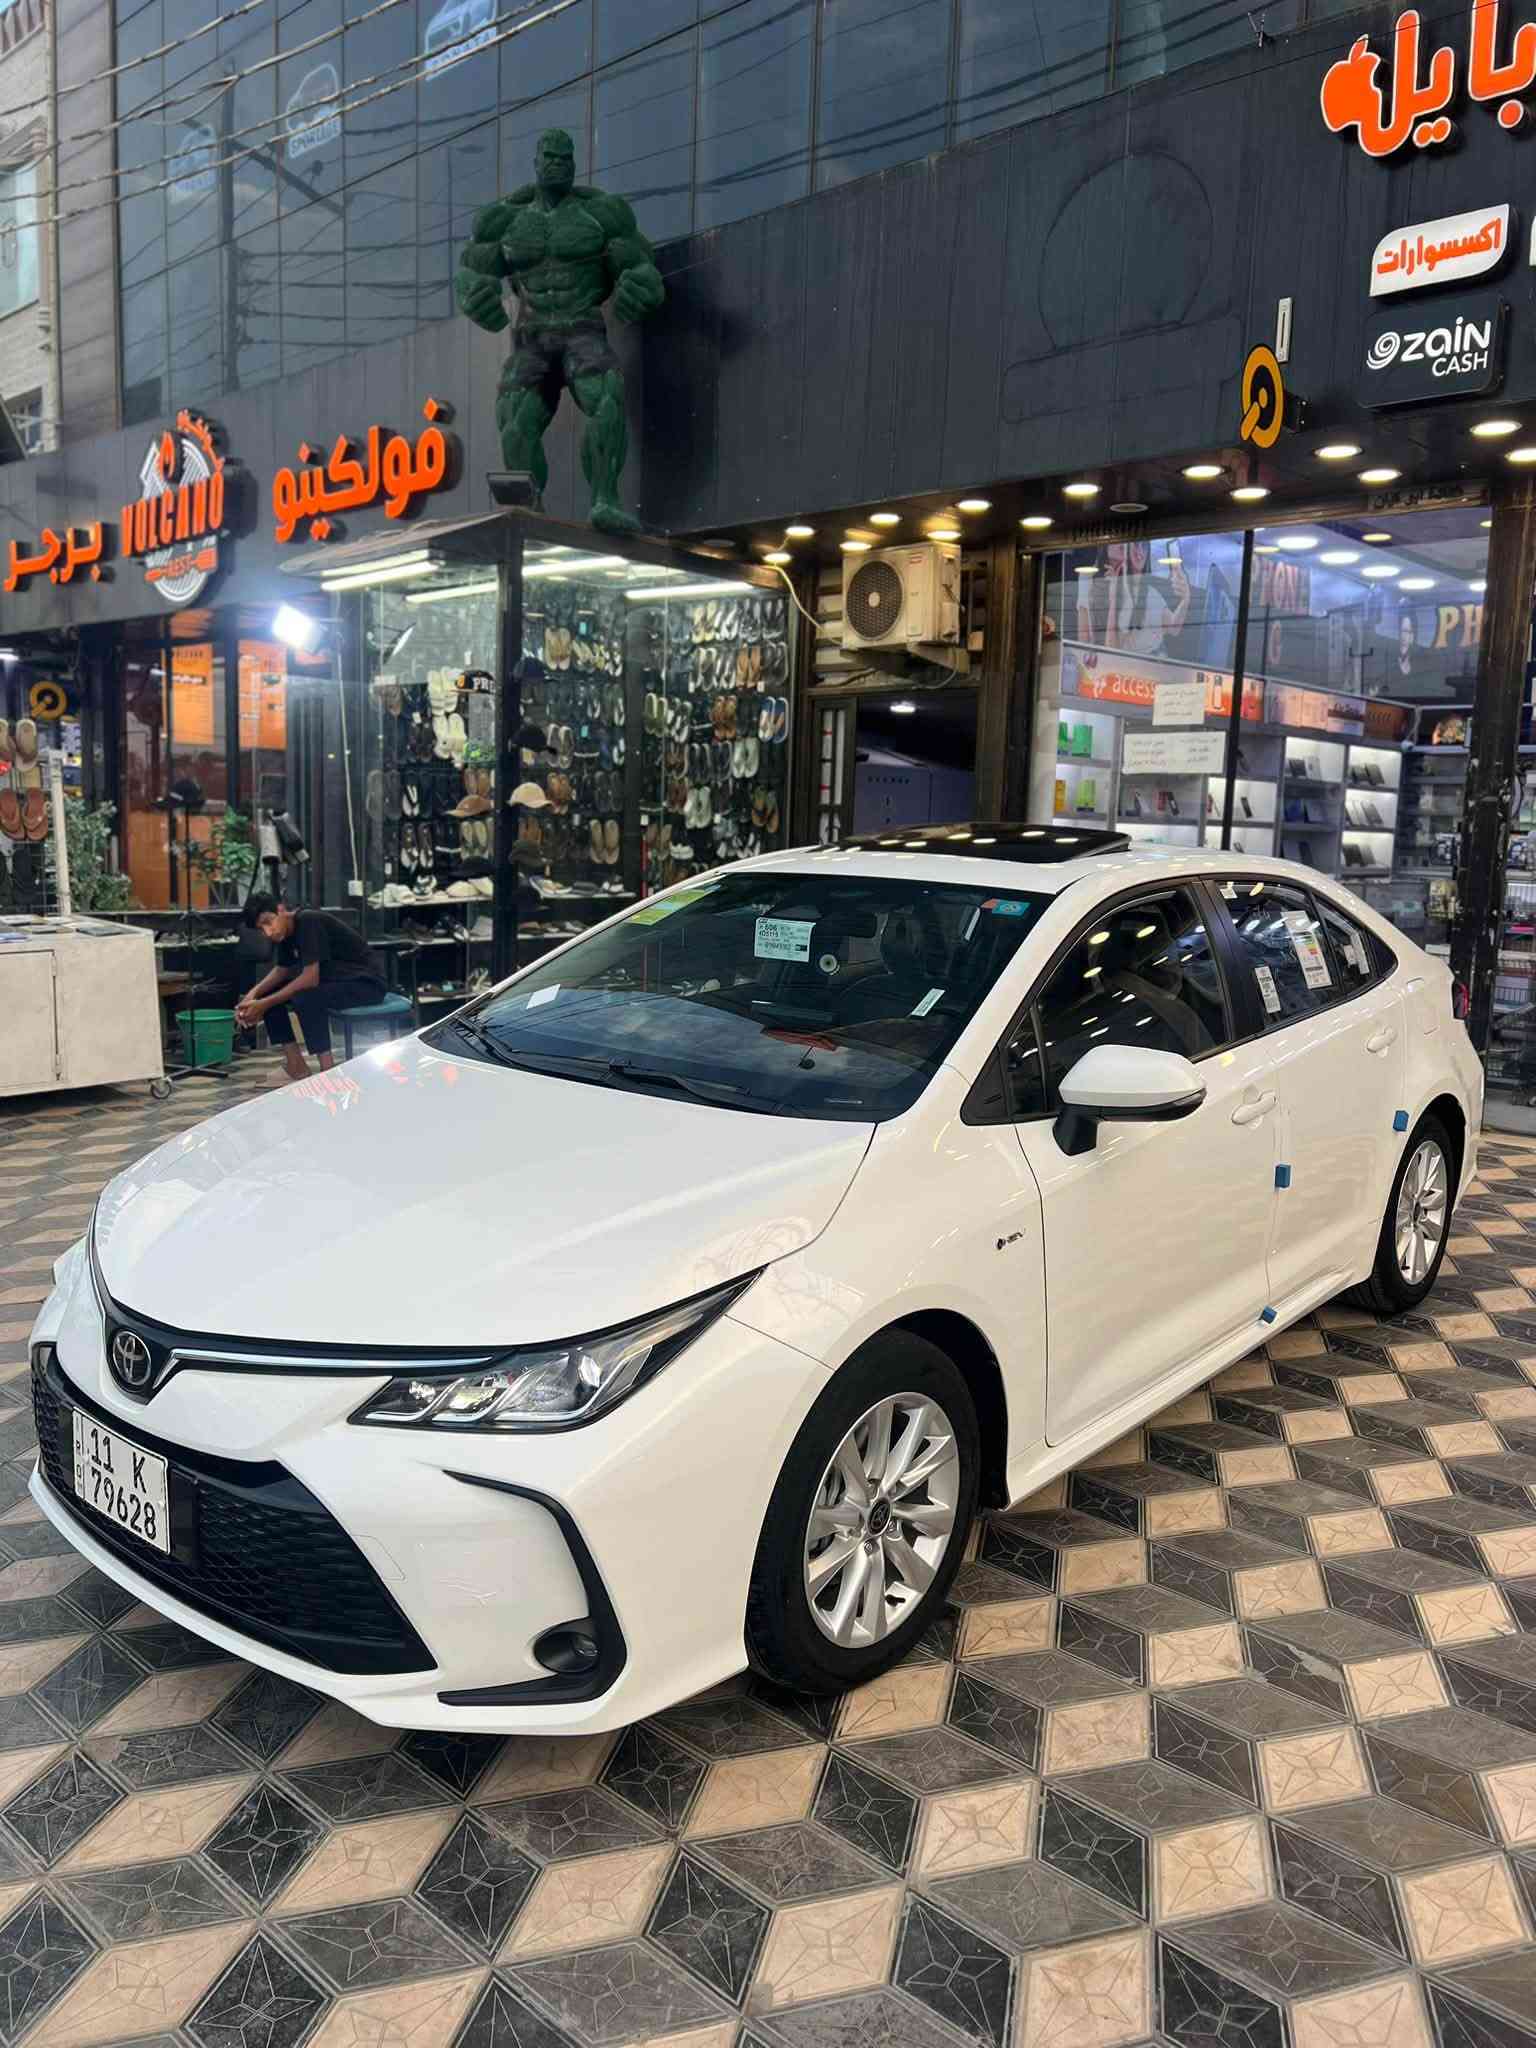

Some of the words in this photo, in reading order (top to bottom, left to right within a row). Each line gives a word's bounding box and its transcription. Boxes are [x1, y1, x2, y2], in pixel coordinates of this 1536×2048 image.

[1376, 217, 1503, 276] اكسسوارات
[1432, 351, 1488, 377] CASH
[272, 396, 447, 545] فولكينو
[120, 471, 224, 558] VOLCANO
[3, 520, 103, 592] برجر
[90, 1428, 114, 1474] 11
[133, 1451, 147, 1494] K
[91, 1466, 157, 1540] 79628
